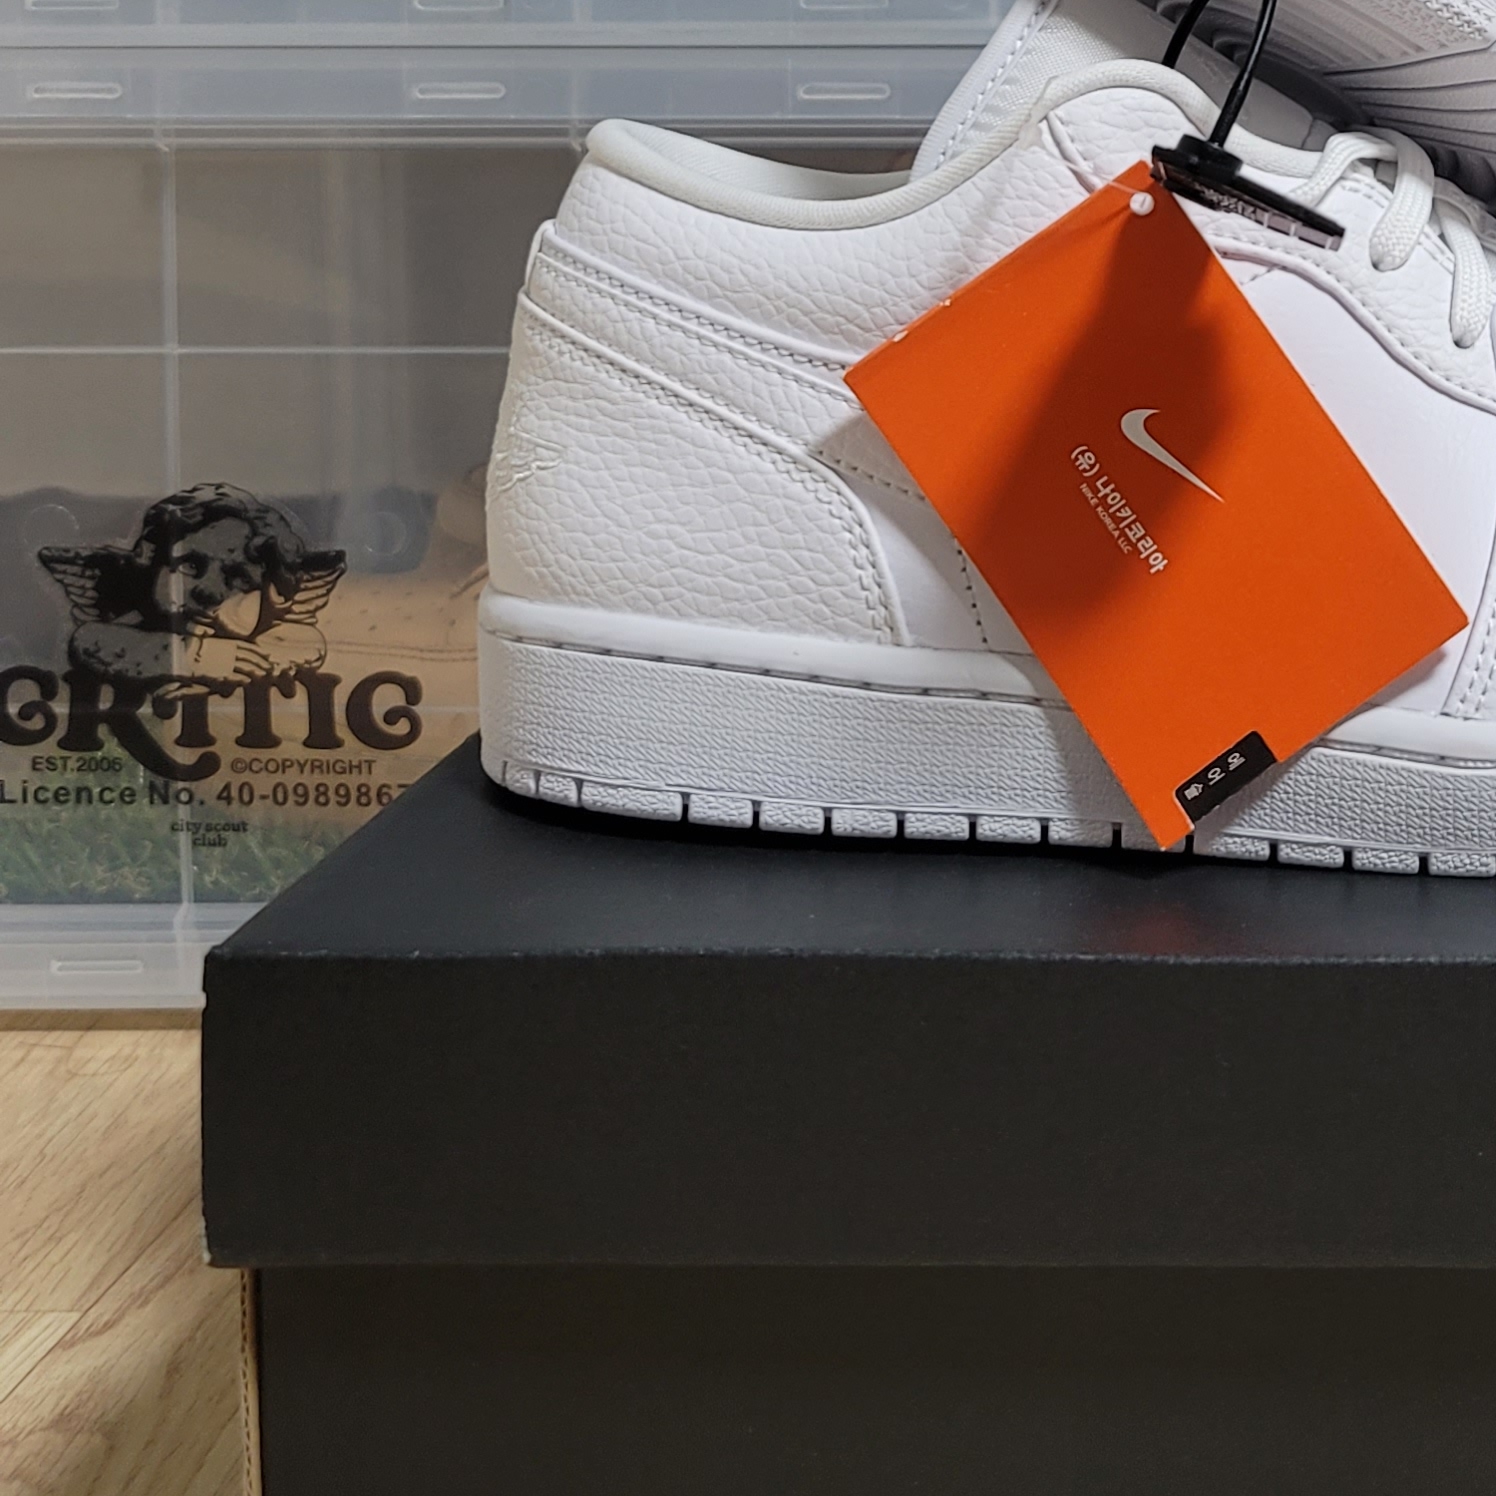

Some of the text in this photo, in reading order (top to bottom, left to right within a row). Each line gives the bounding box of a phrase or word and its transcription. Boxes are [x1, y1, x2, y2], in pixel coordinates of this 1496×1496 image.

[1071, 445, 1169, 574] (유) 나이키코리아
[1079, 483, 1133, 555] NIKE KOREA LLC
[0, 665, 423, 782] CRITIC
[0, 779, 138, 805] Licence
[149, 779, 204, 806] No.
[171, 819, 249, 835] city scout
[193, 833, 228, 848] club
